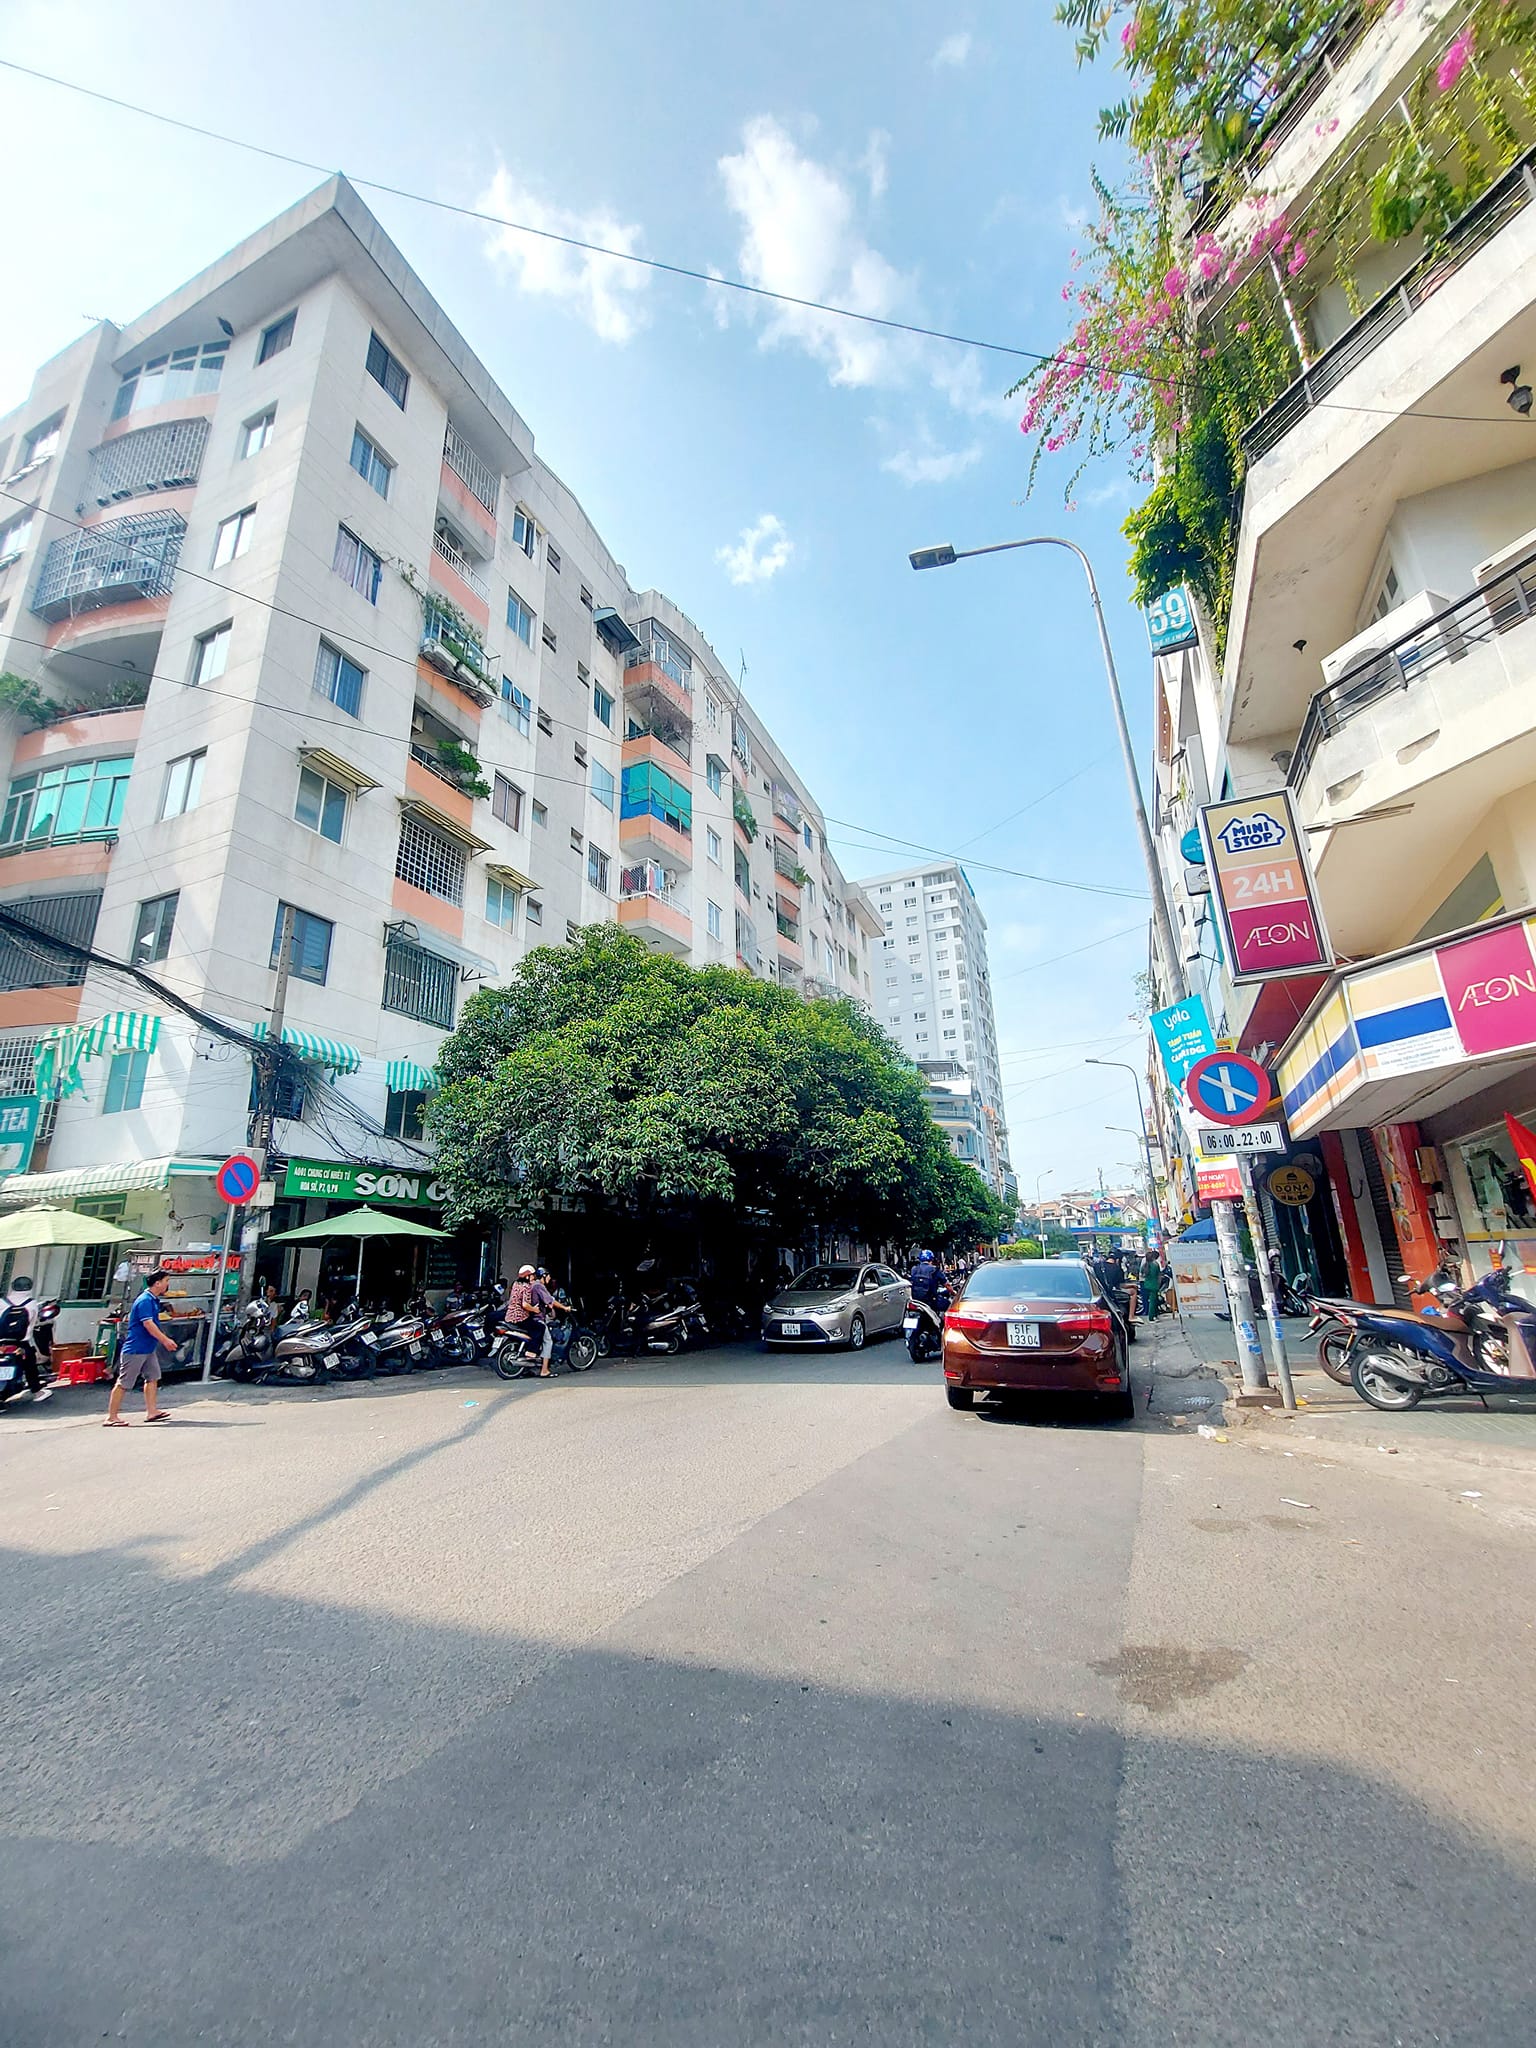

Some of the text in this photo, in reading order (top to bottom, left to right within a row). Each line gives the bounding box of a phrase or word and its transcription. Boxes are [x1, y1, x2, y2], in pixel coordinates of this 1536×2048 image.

[1149, 593, 1187, 635] 59
[1232, 821, 1270, 837] MINI
[1233, 832, 1273, 848] STOP
[1233, 869, 1294, 899] 24H
[0, 1107, 30, 1133] TEA
[353, 1172, 420, 1200] SƠN
[1014, 1323, 1032, 1334] 51F
